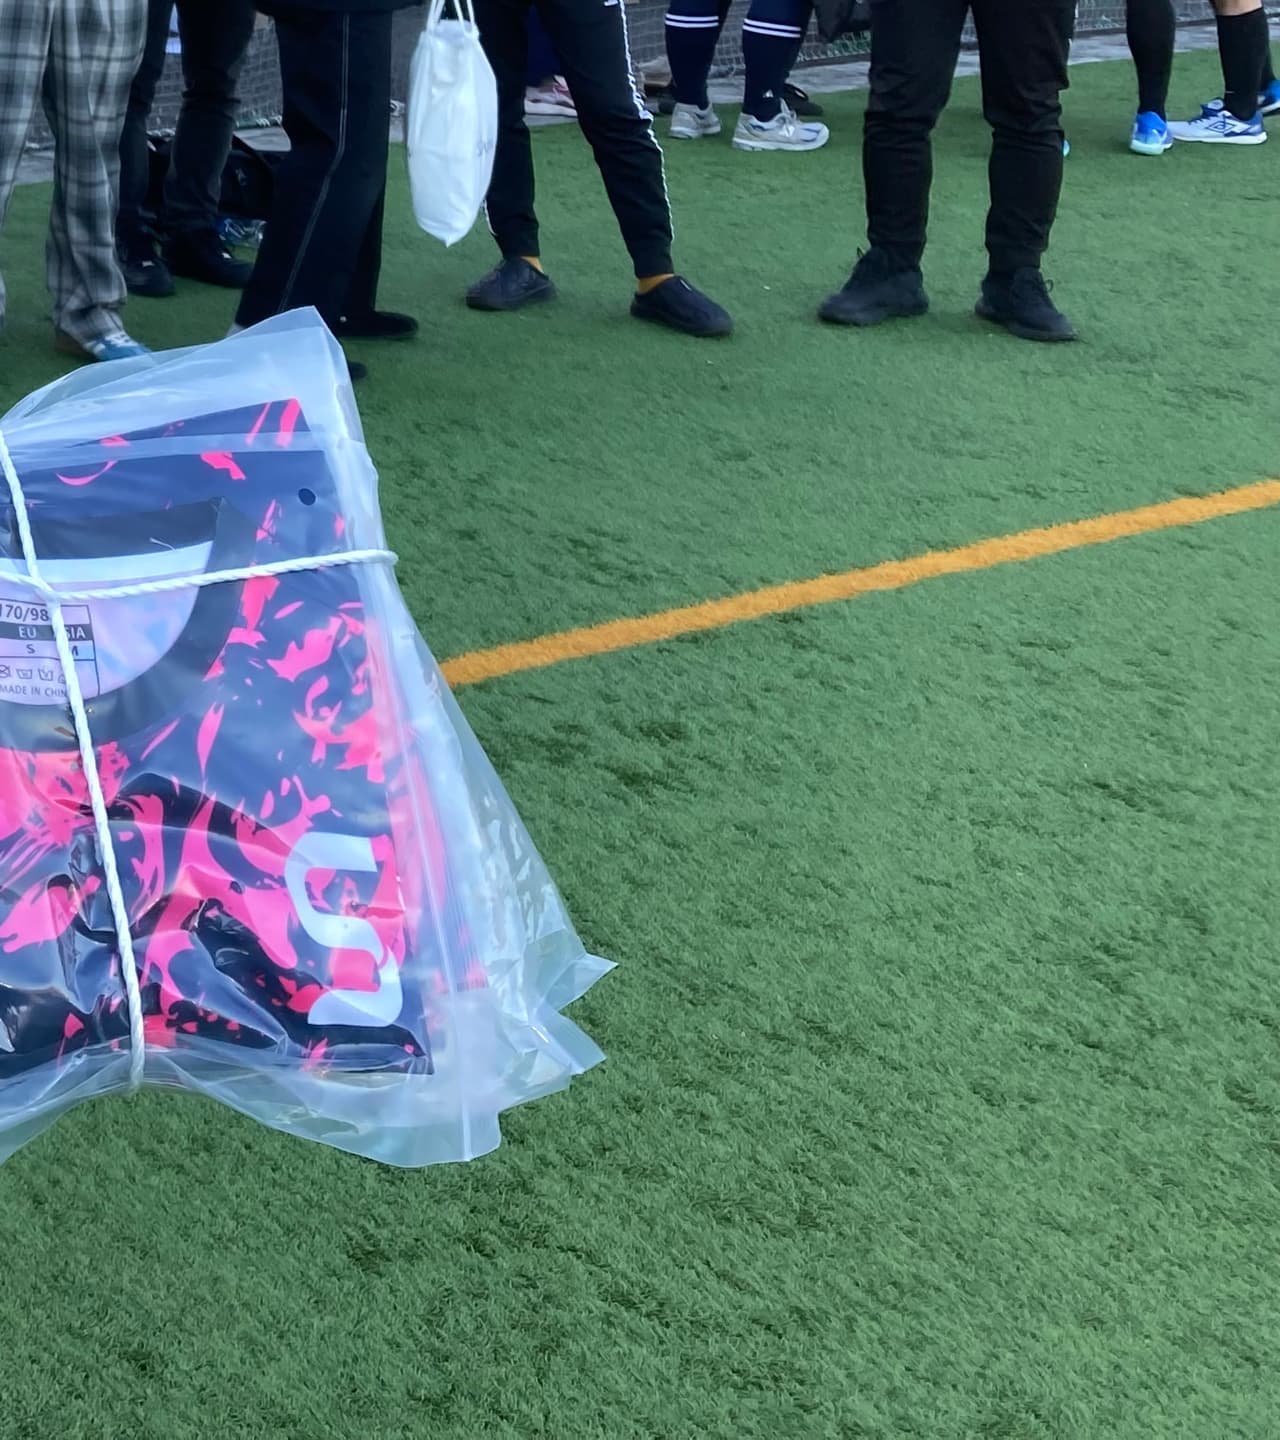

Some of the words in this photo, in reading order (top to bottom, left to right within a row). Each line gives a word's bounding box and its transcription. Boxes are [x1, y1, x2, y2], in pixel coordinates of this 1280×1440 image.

[18, 626, 37, 639] EU
[26, 643, 36, 654] S
[0, 683, 27, 696] MADE
[31, 687, 41, 696] IN
[44, 687, 68, 698] CHIN
